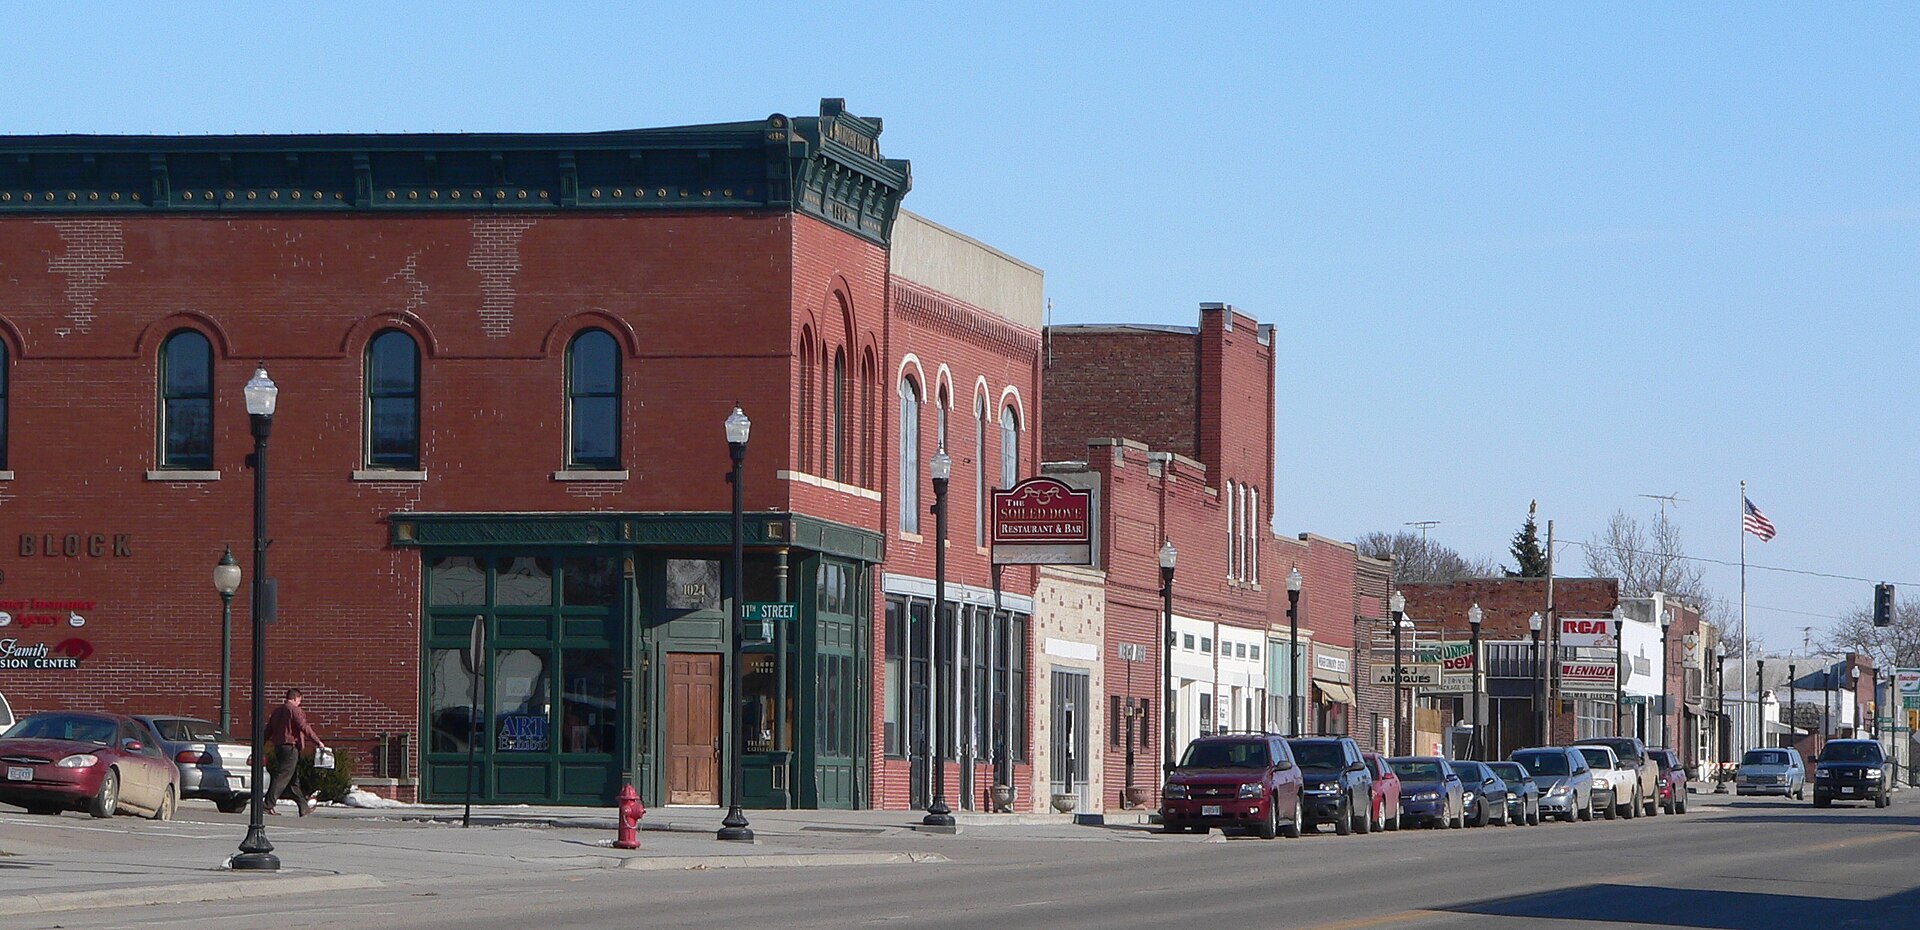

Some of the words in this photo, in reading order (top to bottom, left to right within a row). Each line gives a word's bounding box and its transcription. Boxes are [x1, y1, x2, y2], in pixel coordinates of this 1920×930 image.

[1006, 499, 1024, 507] THE
[1000, 508, 1046, 519] SOILED
[1050, 508, 1082, 519] DOVE
[1056, 524, 1062, 533] &
[20, 534, 131, 557] BLOCK
[682, 584, 705, 595] 1024
[741, 605, 757, 618] 11TH
[761, 604, 795, 618] STREET
[1563, 621, 1606, 634] RCA
[0, 638, 48, 658] Family
[34, 659, 77, 668] CENTER
[1411, 667, 1417, 675] J
[1568, 666, 1610, 676] LENNOX
[1380, 675, 1431, 683] ANIQUES
[500, 716, 546, 736] ART
